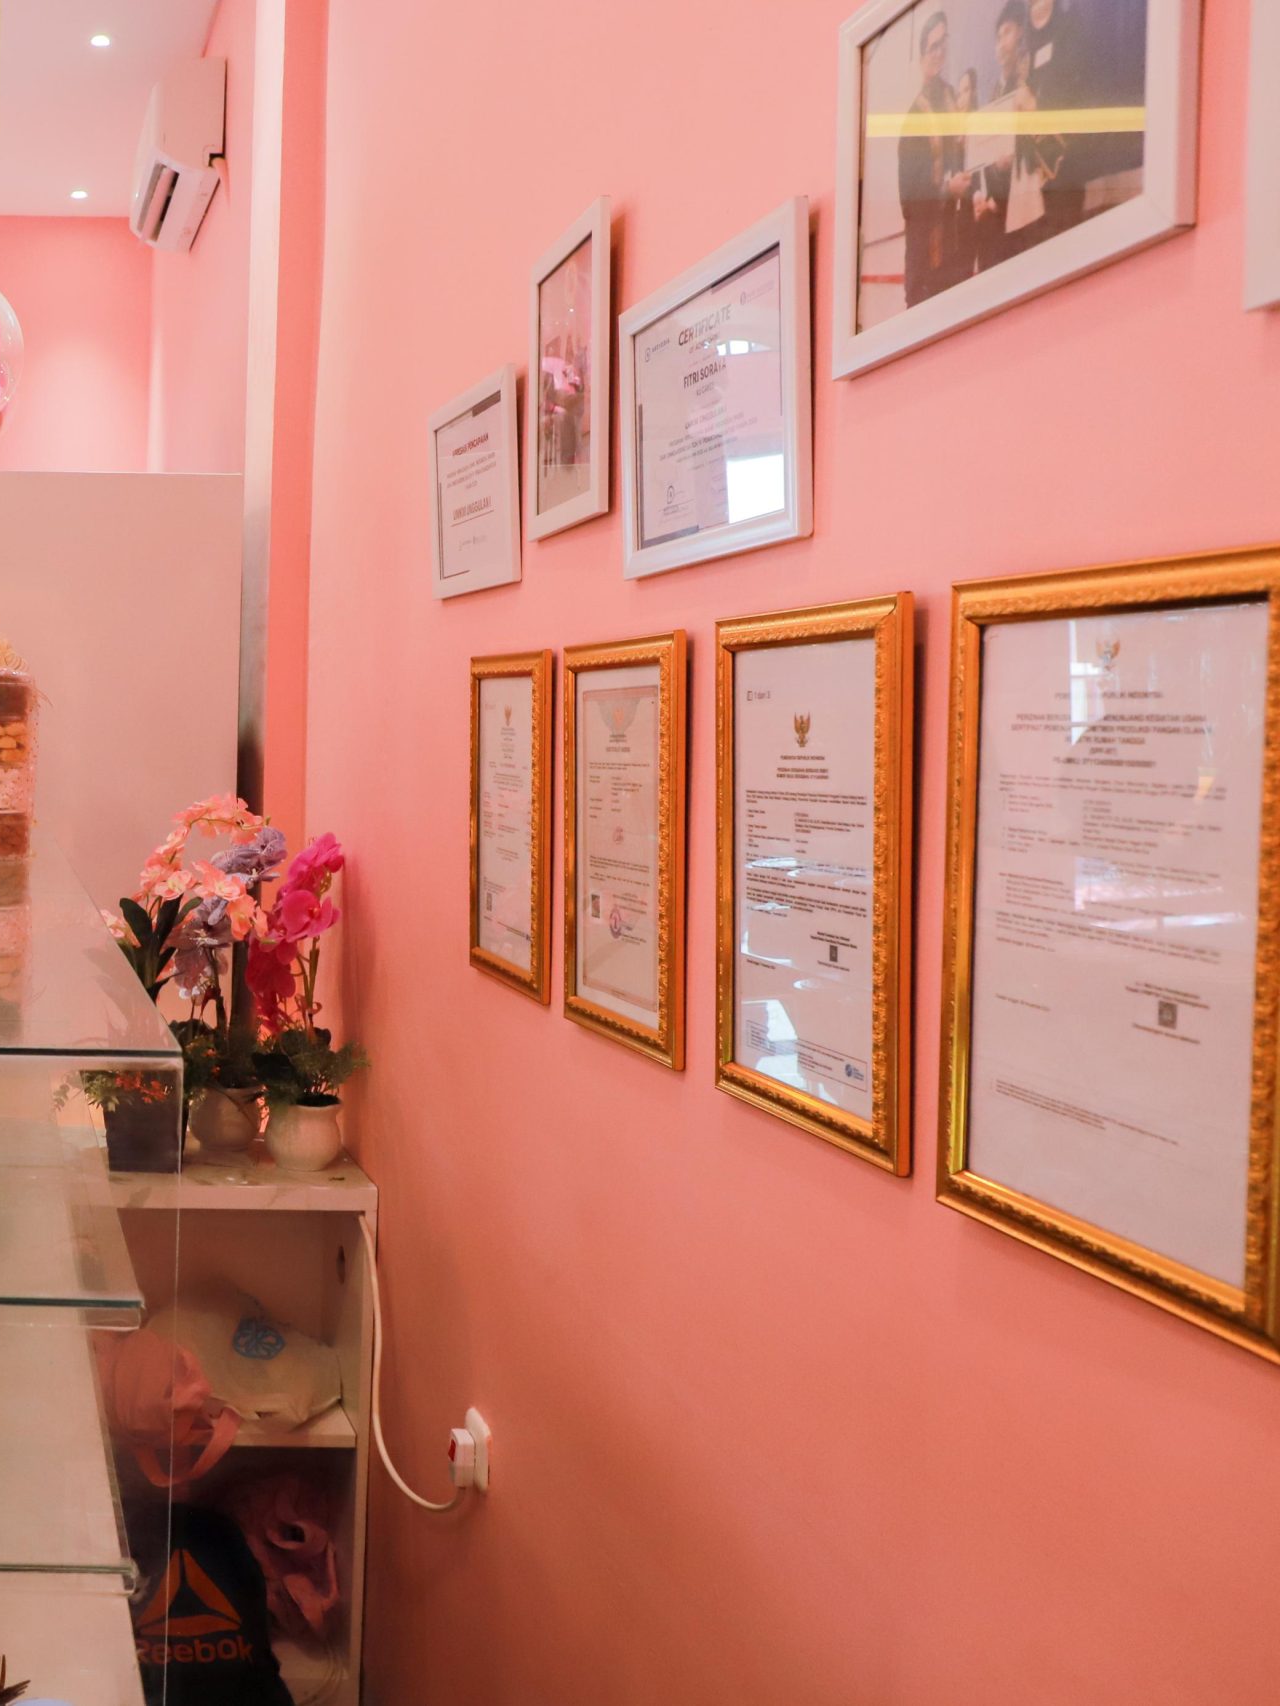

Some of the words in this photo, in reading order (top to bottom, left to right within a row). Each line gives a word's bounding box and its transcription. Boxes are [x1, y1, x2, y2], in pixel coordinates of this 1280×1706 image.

[677, 304, 731, 346] CERTIFICATE
[683, 369, 700, 390] FITRI
[136, 1634, 253, 1665] Reebok
